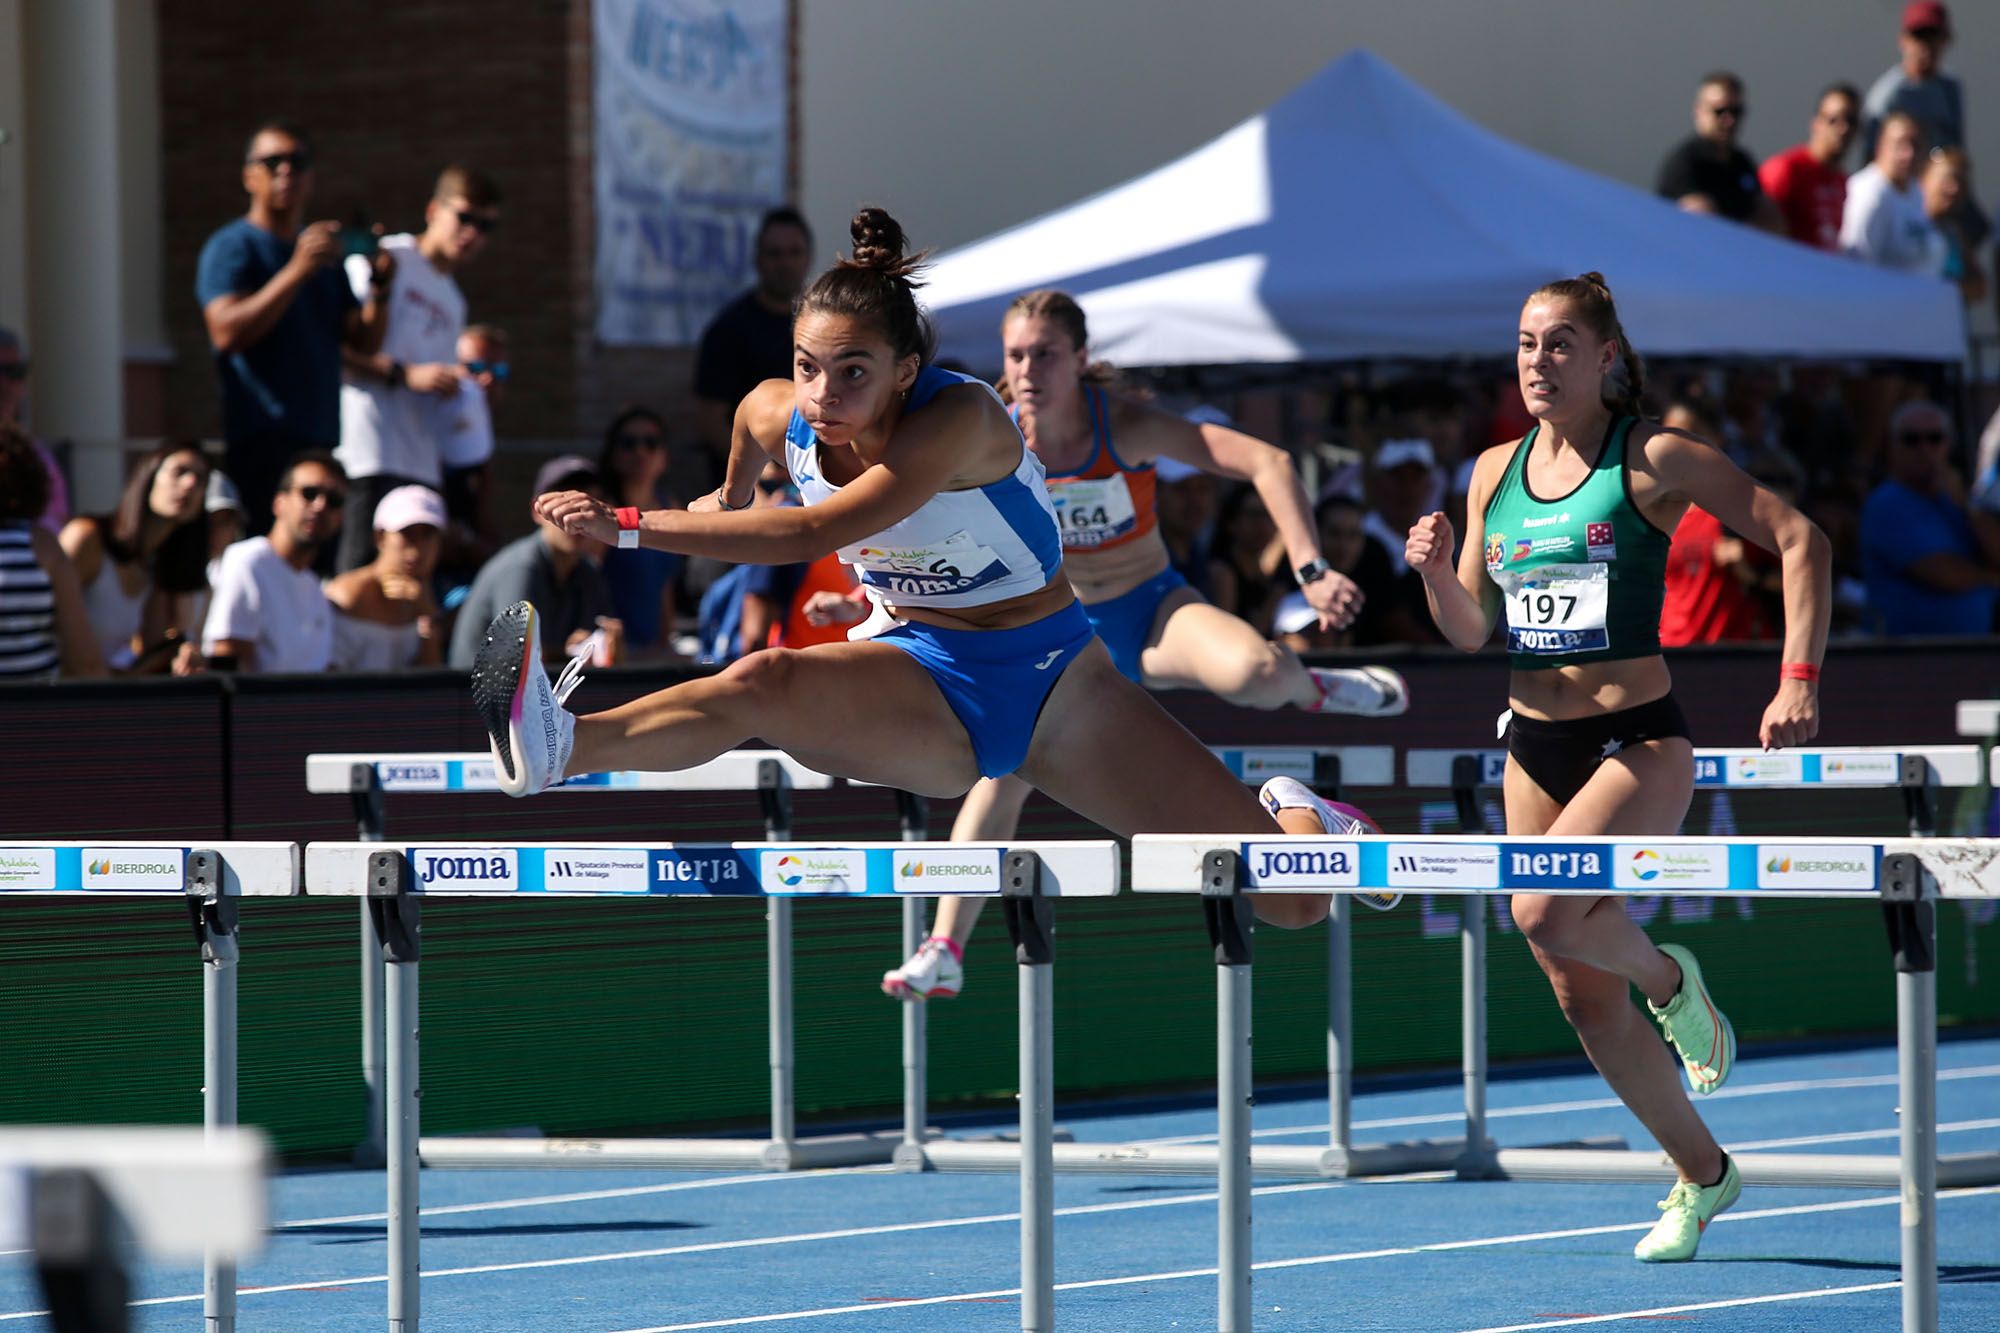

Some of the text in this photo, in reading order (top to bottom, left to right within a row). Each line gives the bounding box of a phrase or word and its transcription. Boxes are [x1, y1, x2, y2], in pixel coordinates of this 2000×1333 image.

[1521, 593, 1579, 625] 197
[112, 863, 177, 874] IBERDROLA
[926, 864, 993, 876] IBERDROLA
[1793, 860, 1867, 873] IBERDROLA
